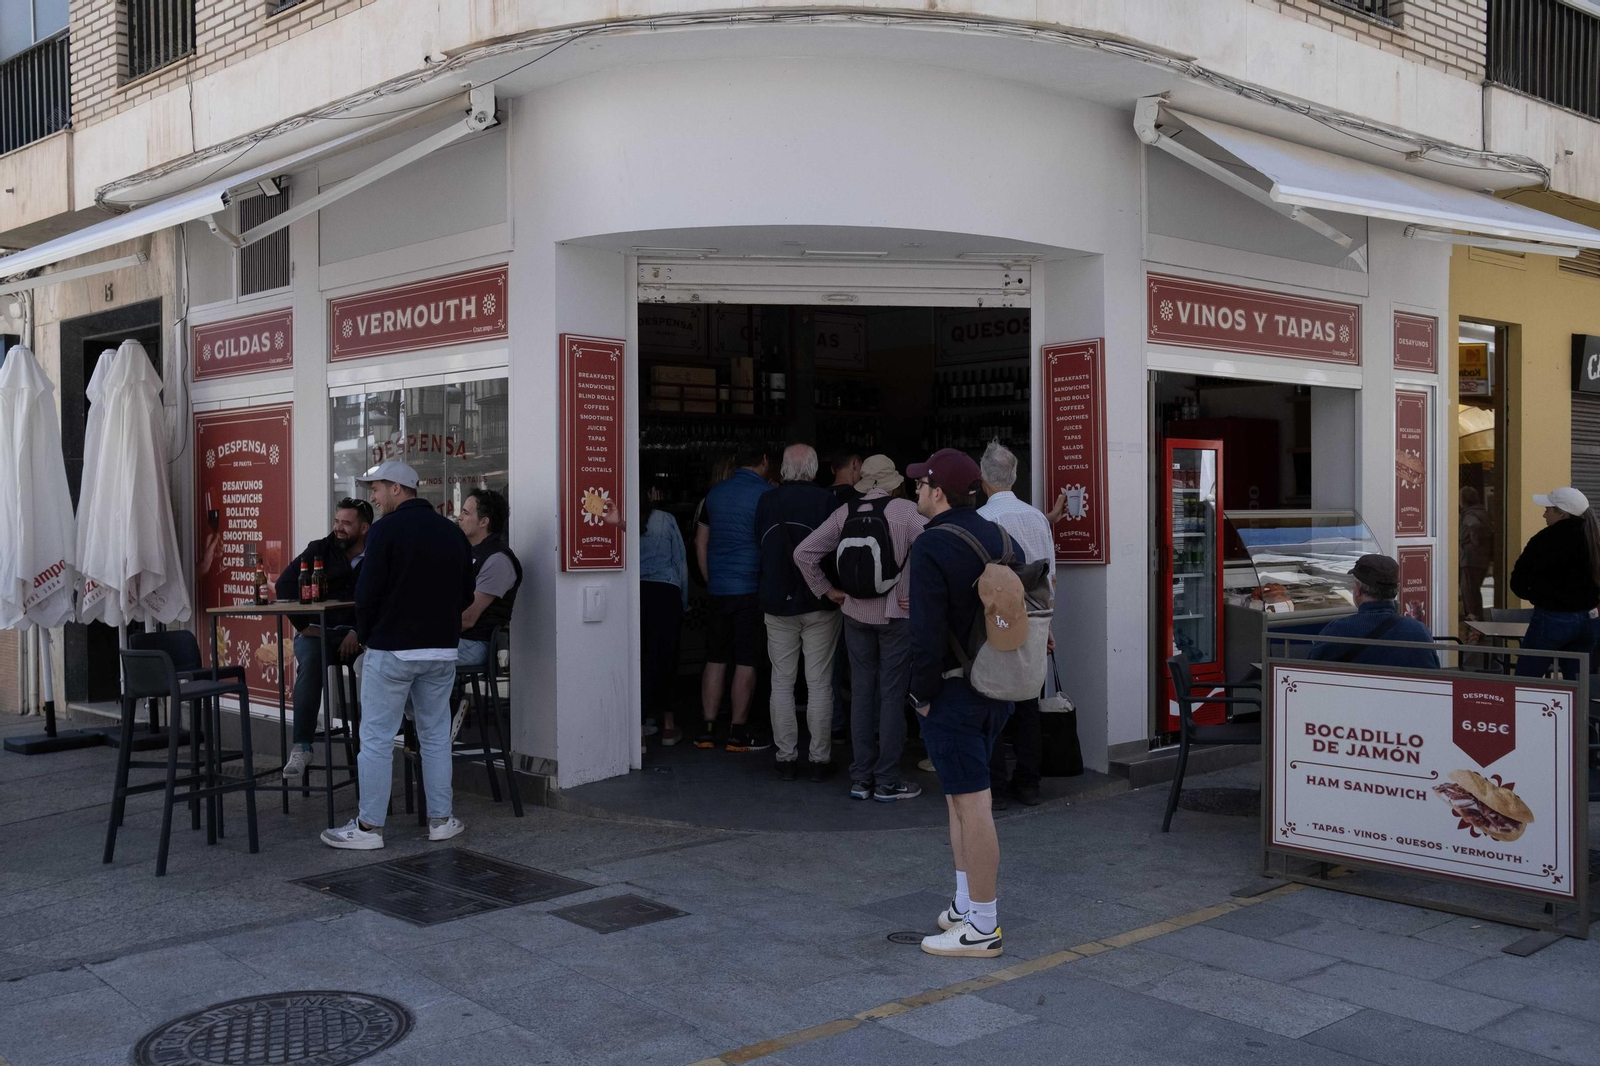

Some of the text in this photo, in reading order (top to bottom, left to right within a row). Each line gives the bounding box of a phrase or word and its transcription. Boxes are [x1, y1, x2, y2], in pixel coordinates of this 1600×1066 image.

[356, 296, 476, 336] VERMOUTH
[1176, 301, 1336, 342] VINOS Y TAPAS
[214, 332, 271, 359] GILDAS
[1398, 338, 1428, 348] DESAYUNOS
[579, 372, 615, 380] BREAKFASTS
[1054, 374, 1089, 382] BREAKFASTS
[1054, 384, 1090, 392] SANDWICHES
[218, 439, 266, 458] DESPENSA
[372, 434, 467, 464] DESPENSA
[222, 480, 263, 491] DESAYUNOS
[448, 476, 488, 484] COCKTAILS
[223, 494, 262, 504] SANDWICHS
[226, 507, 259, 517] BOLLITOS
[228, 519, 257, 529] BATIDOS
[223, 531, 262, 541] SMOOTHIES
[223, 543, 244, 554] TAPAS
[34, 559, 66, 588] ampo
[231, 571, 255, 582] ZUMOS
[224, 584, 255, 595] ENSALAD
[996, 614, 1009, 628] LA
[1462, 693, 1504, 703] DESPENSA
[1462, 720, 1510, 735] 6,95€
[1305, 722, 1424, 749] BOCADILLO
[1312, 739, 1420, 764] DE JAMÓN
[1306, 775, 1427, 801] HAM SANDWICH
[1312, 822, 1522, 864] TAPAS VINOS QUESOS VERMOUTH
